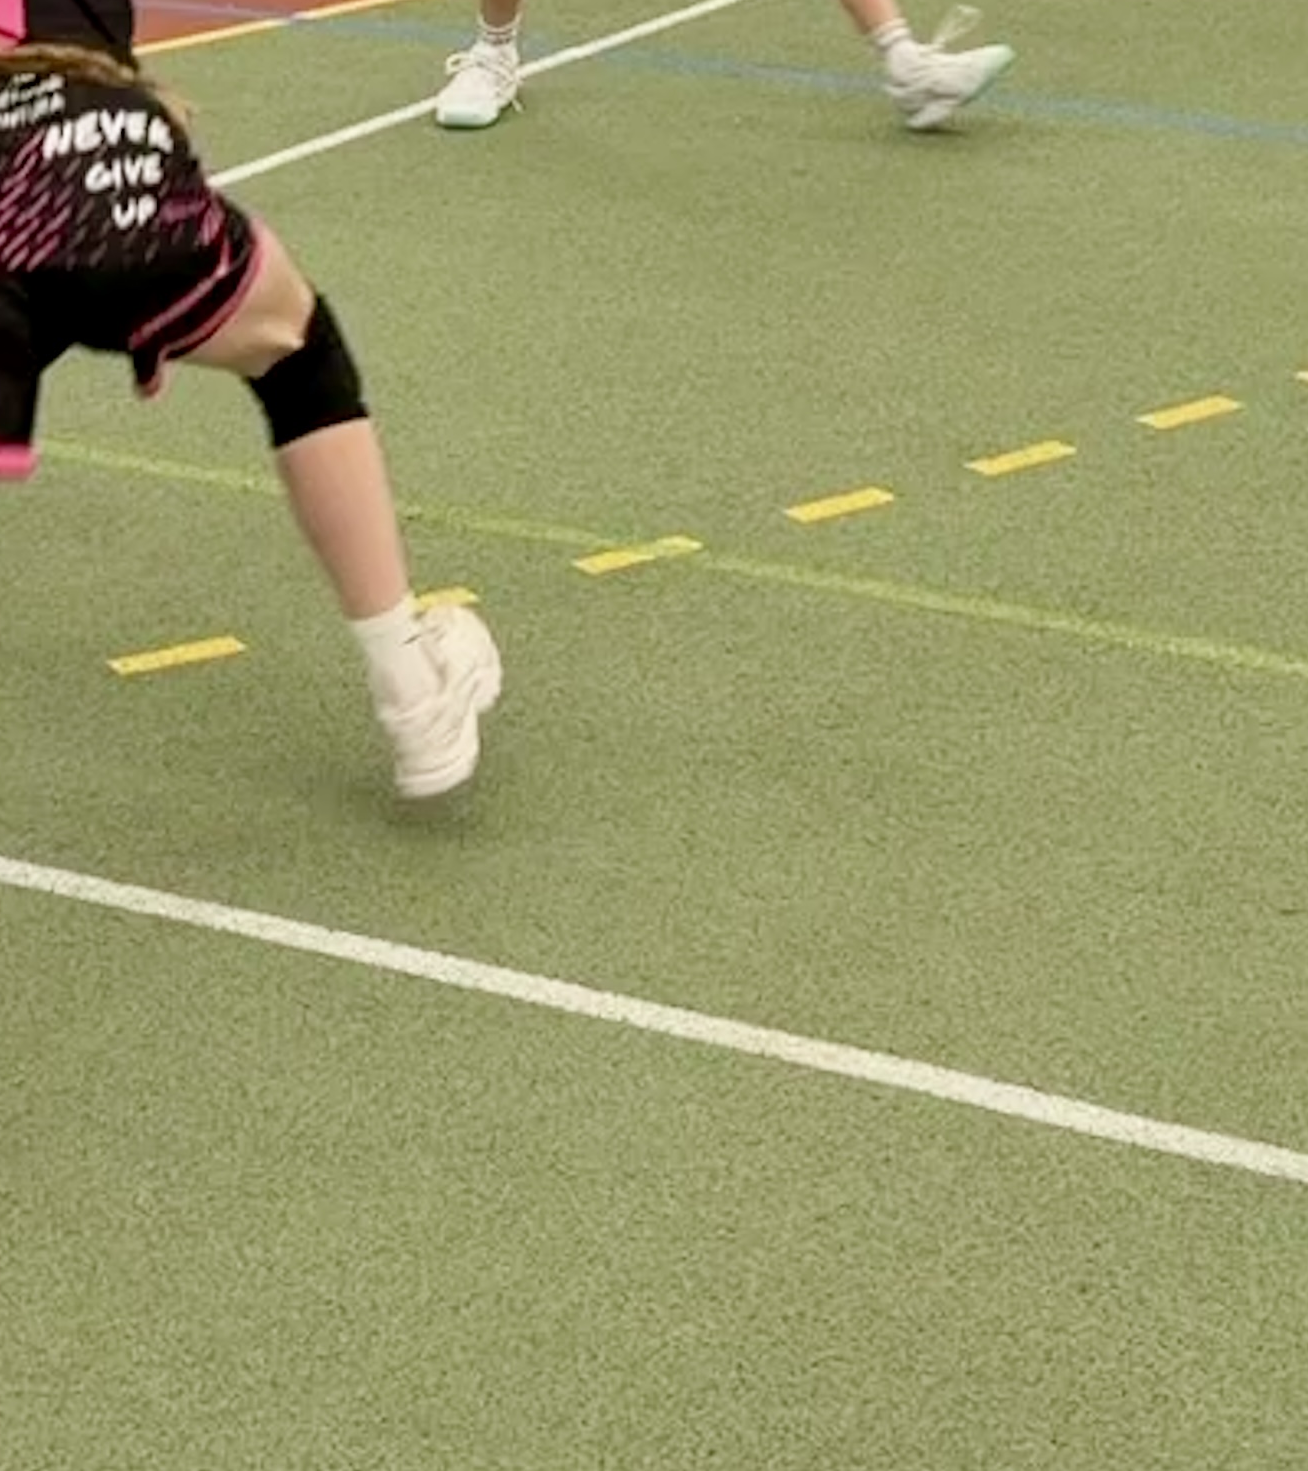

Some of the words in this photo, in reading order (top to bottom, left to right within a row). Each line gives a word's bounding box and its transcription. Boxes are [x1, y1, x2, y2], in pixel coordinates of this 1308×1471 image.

[43, 108, 173, 162] NEVER
[85, 151, 163, 193] GIVE
[113, 193, 157, 230] UP
